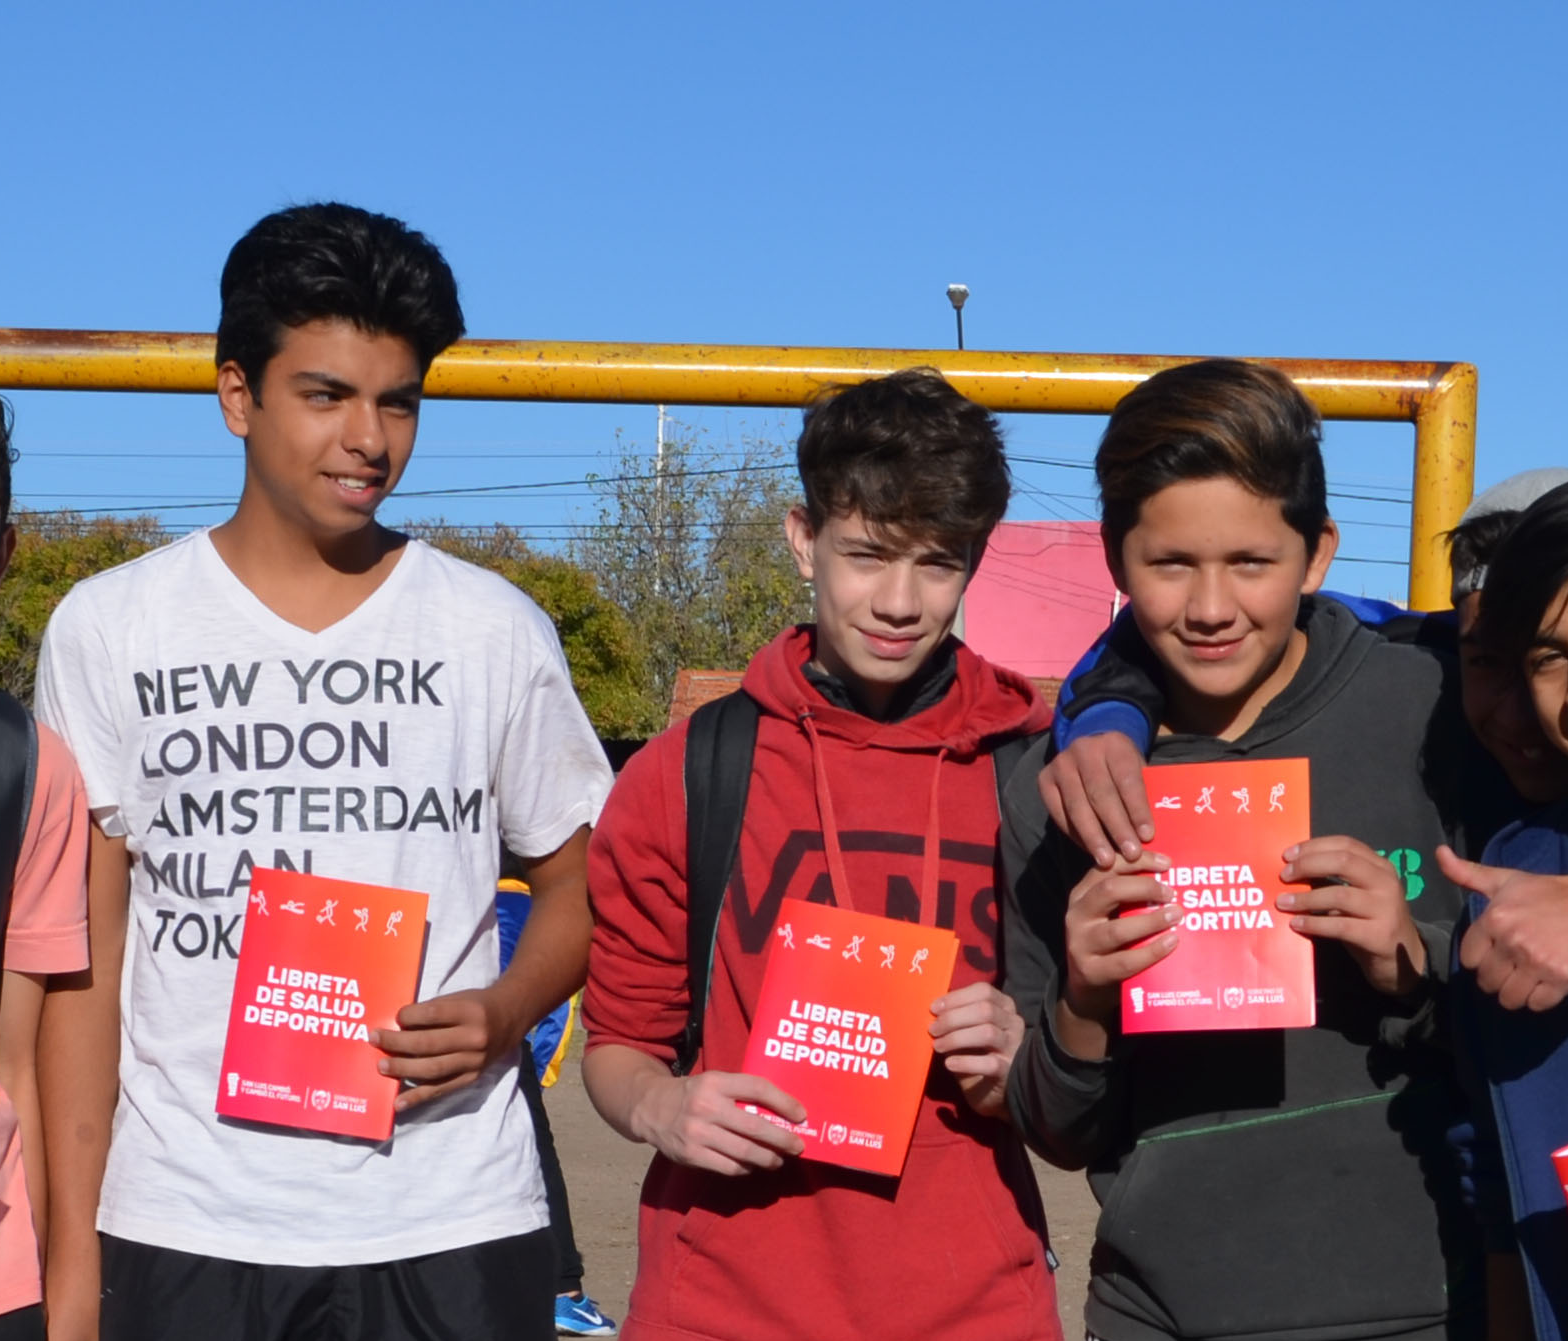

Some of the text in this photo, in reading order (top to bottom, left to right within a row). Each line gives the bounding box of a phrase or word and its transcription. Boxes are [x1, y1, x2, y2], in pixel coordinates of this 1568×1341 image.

[133, 658, 445, 717] NEW YORK
[141, 721, 389, 779] LONDON
[146, 785, 483, 838] AMSTERDAM
[1155, 864, 1255, 886] LIBRETA
[1182, 887, 1264, 908] SALUD
[267, 965, 360, 998] LIBRETA
[255, 985, 366, 1019] DE SALUD
[789, 999, 882, 1034] LIBRETA
[244, 1005, 369, 1042] DEPORTIVA
[777, 1018, 887, 1056] DE SALUD
[764, 1038, 889, 1080] DEPORTIVA
